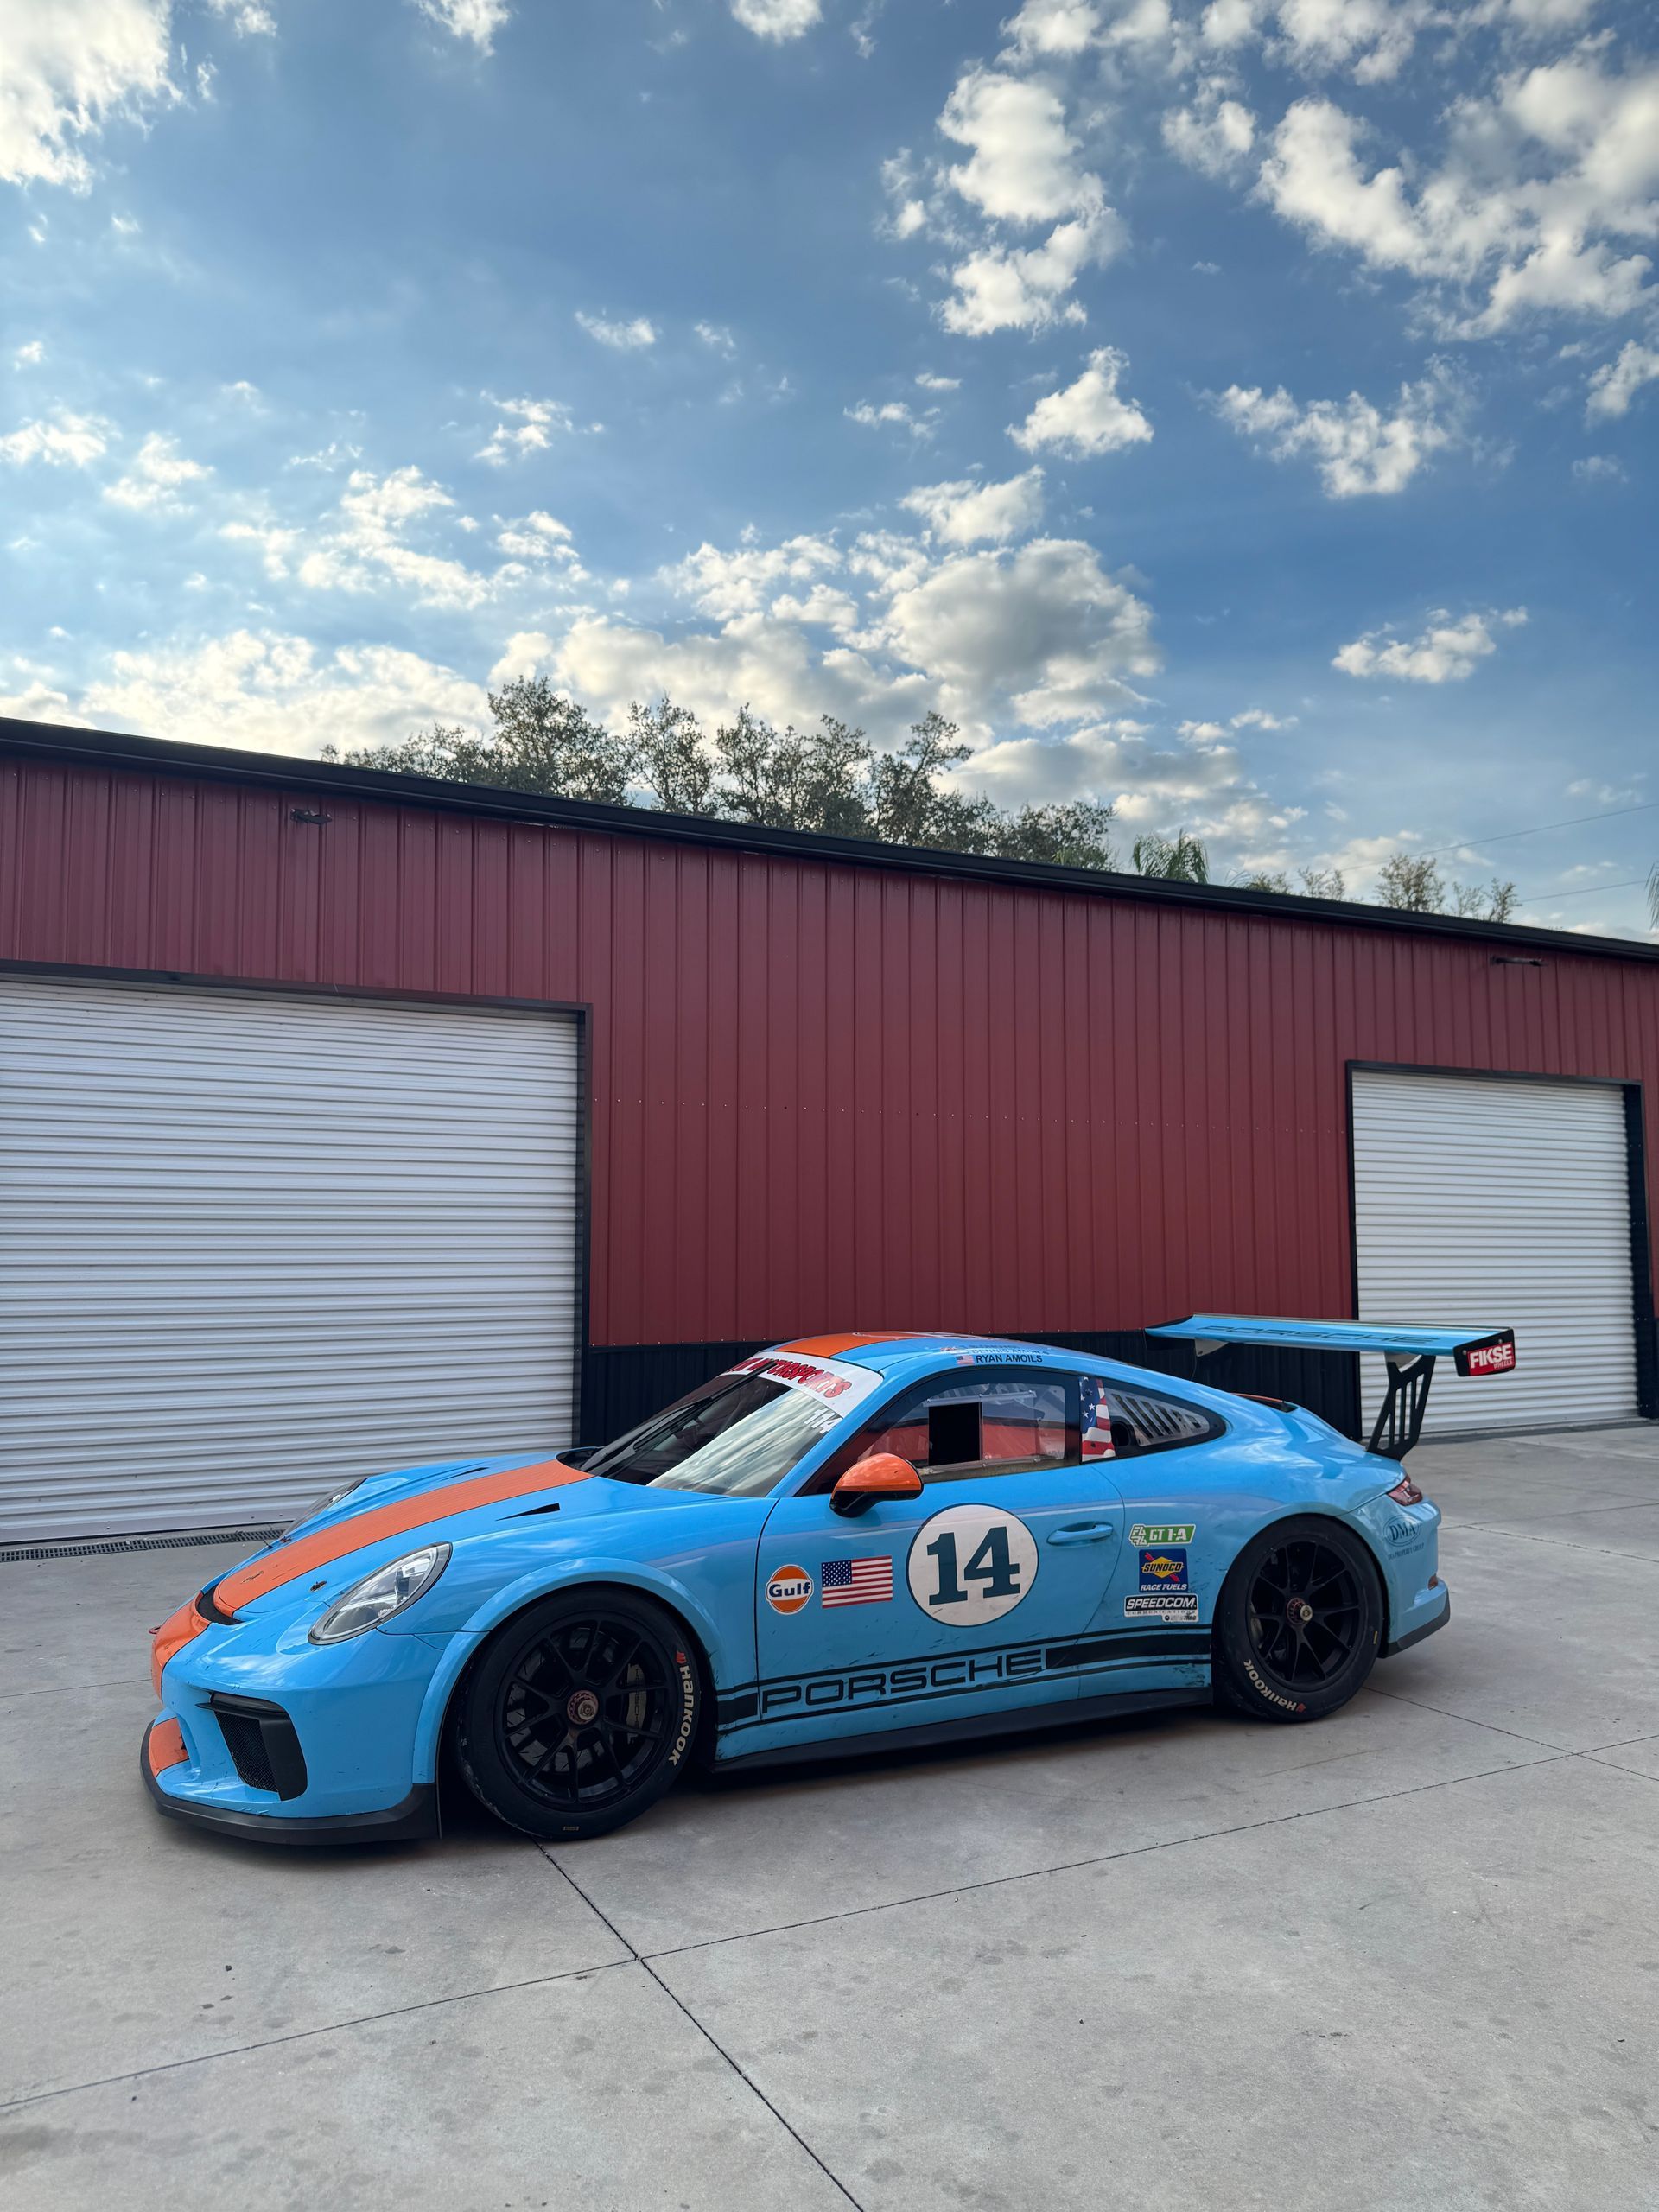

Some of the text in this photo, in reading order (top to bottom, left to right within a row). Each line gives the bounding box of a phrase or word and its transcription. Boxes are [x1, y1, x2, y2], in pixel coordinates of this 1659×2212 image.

[976, 1354, 1043, 1363] RYAN AMOILS
[1470, 1344, 1513, 1369] FIKSE
[1493, 1359, 1513, 1370] WHEELS
[1149, 1529, 1166, 1541] GT
[1389, 1522, 1416, 1541] DMA
[926, 1526, 1020, 1605] 14
[1143, 1562, 1183, 1573] SUNOCO
[768, 1581, 811, 1599] Gulf
[1140, 1583, 1161, 1592] RACE
[761, 1649, 1042, 1713] PORSCHE
